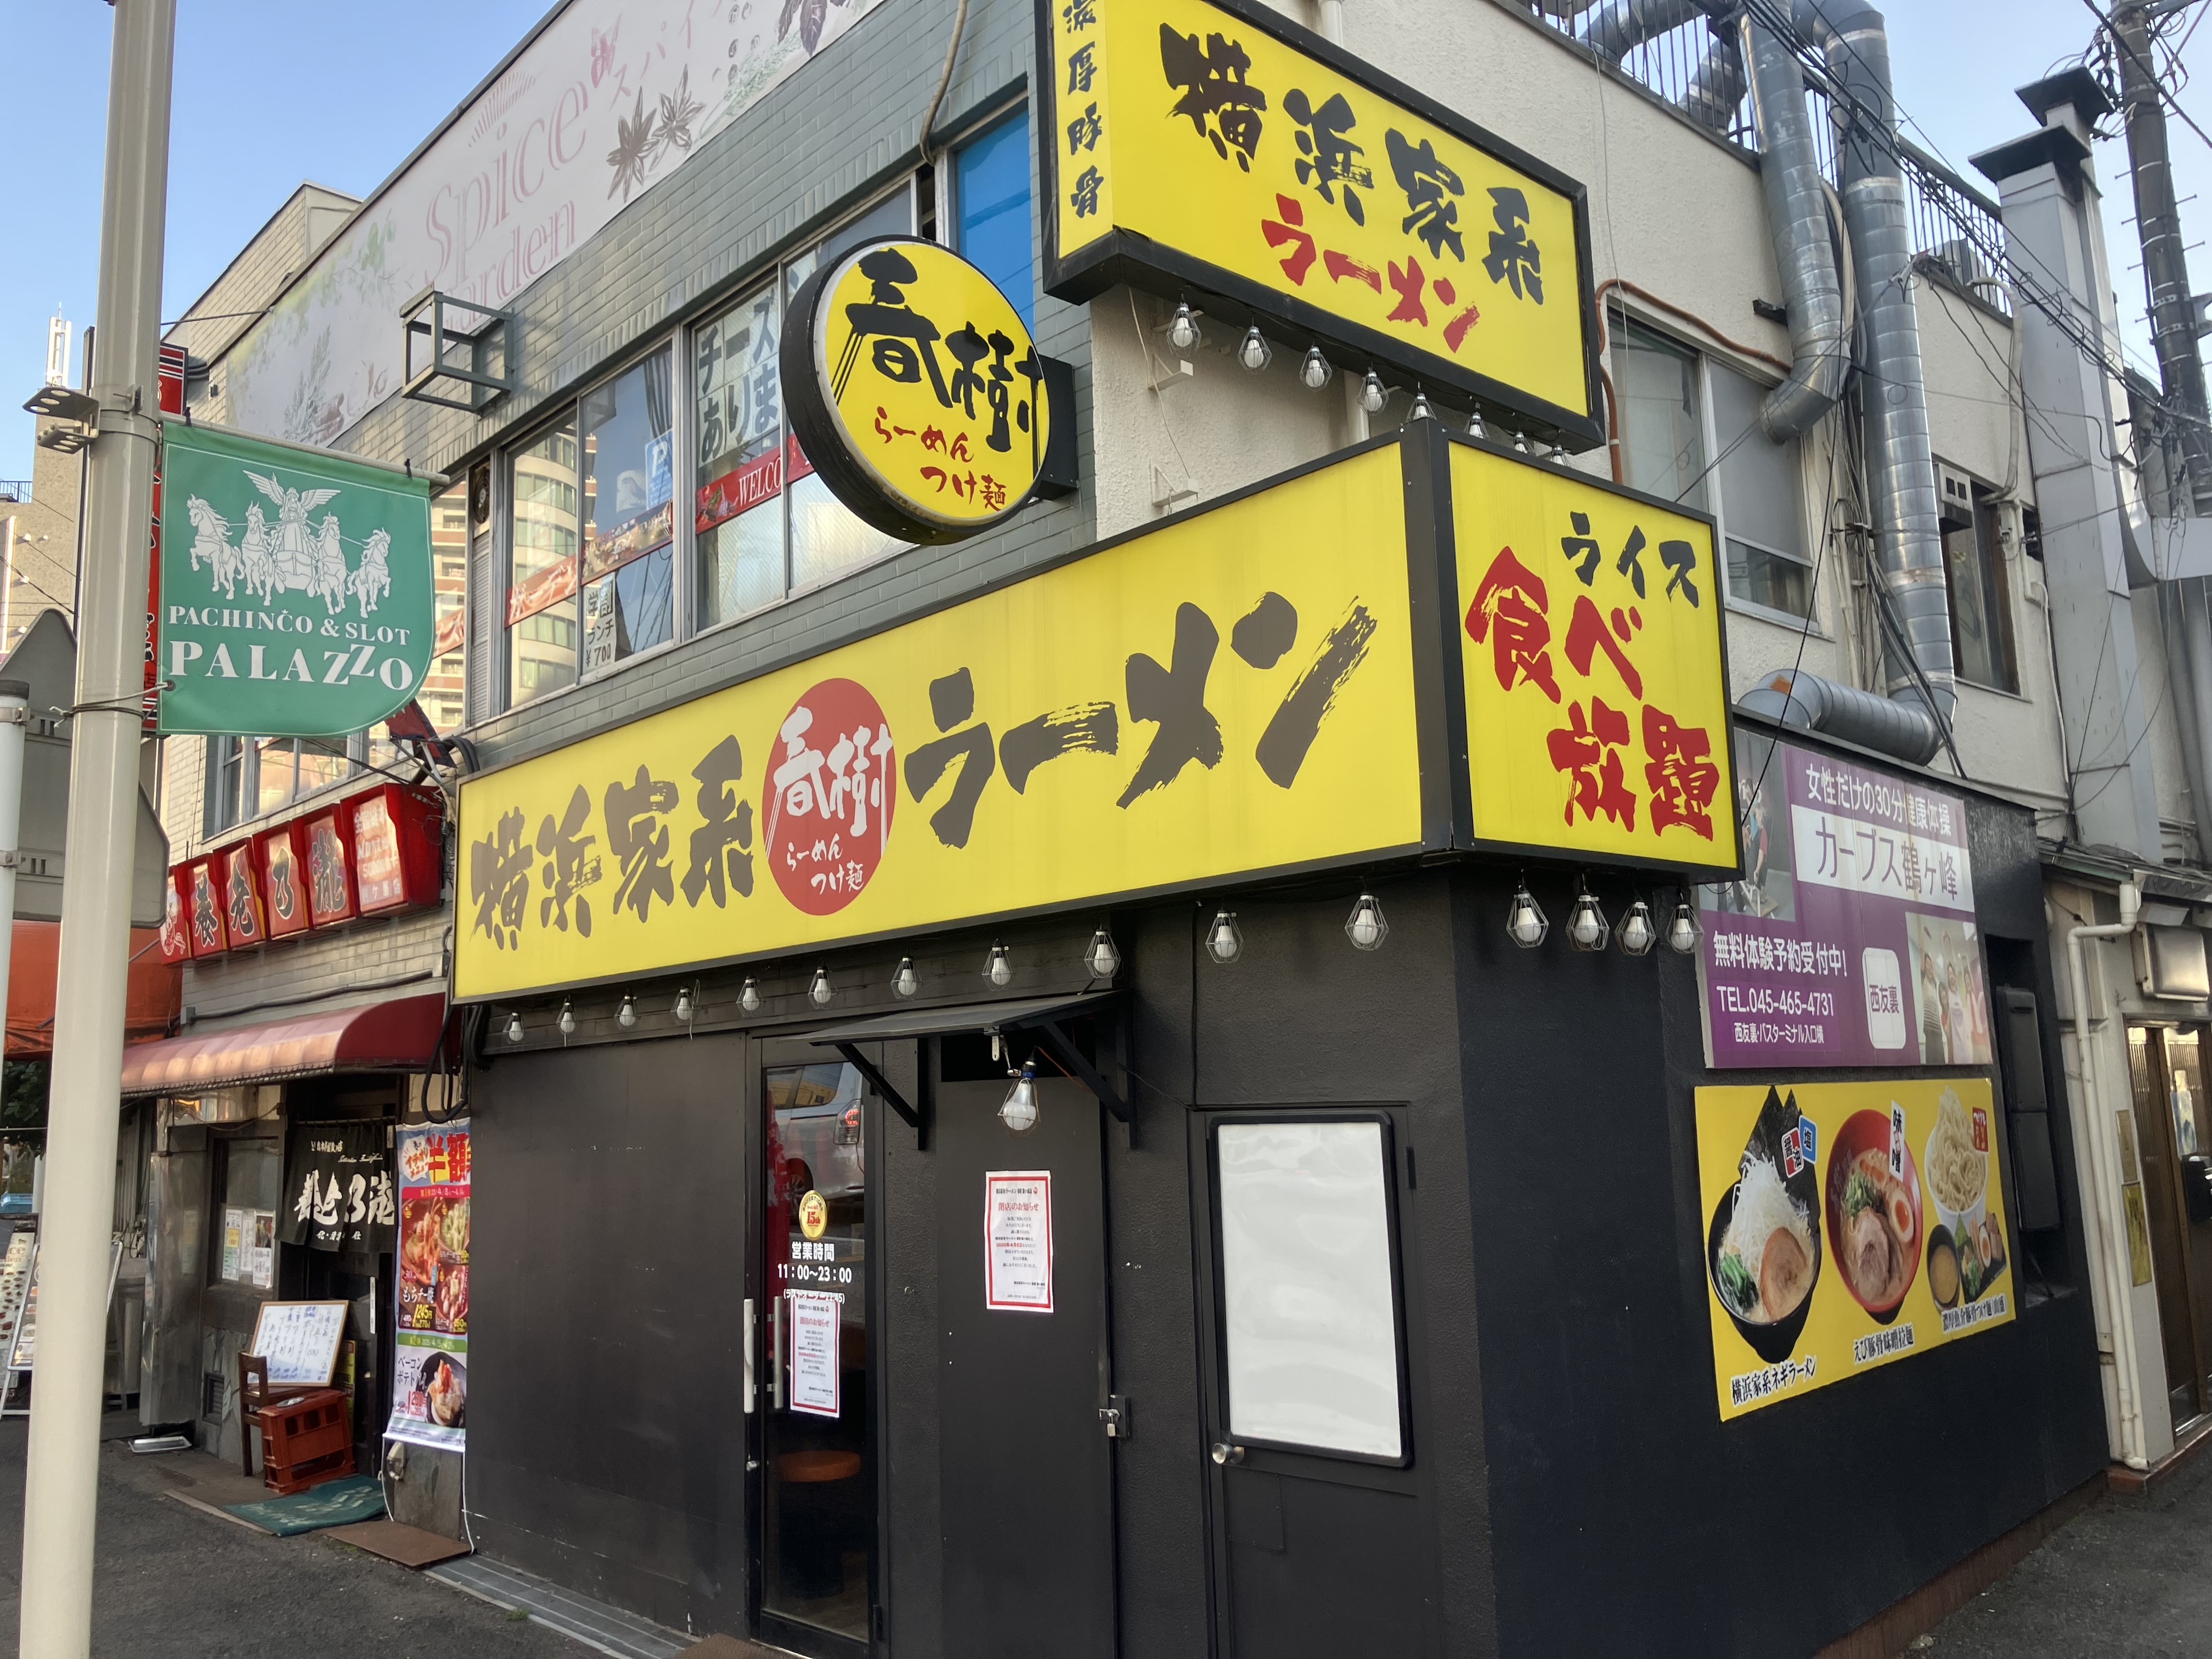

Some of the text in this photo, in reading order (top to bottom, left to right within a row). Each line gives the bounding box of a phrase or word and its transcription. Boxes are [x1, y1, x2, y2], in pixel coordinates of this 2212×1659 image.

[1159, 22, 1544, 306] 横浜家系
[1261, 193, 1481, 353] ラーメン
[832, 248, 1045, 478] 春樹
[874, 407, 974, 462] らーめん
[920, 466, 1007, 512] つけ麺
[1561, 511, 1699, 608] ライス
[320, 618, 341, 637] &
[345, 622, 411, 646] SLOT
[588, 618, 614, 646] ランチ
[1464, 545, 1645, 704] 食べ
[169, 640, 414, 691] PALAZZO
[470, 591, 1378, 952] 横浜家系 ラーメン
[766, 706, 894, 857] 春樹
[1546, 696, 1720, 842] 放題
[1805, 763, 1952, 837] 女性だけの30分健康体操
[786, 832, 843, 873] らーめん
[811, 859, 865, 896] つけ麺
[1716, 985, 1835, 1016] TEL.045-465-4731
[1868, 983, 1901, 1015] 西友裏
[791, 1241, 835, 1262] 営業時間
[1731, 1356, 1817, 1406] 横浜家系ネギラーメン
